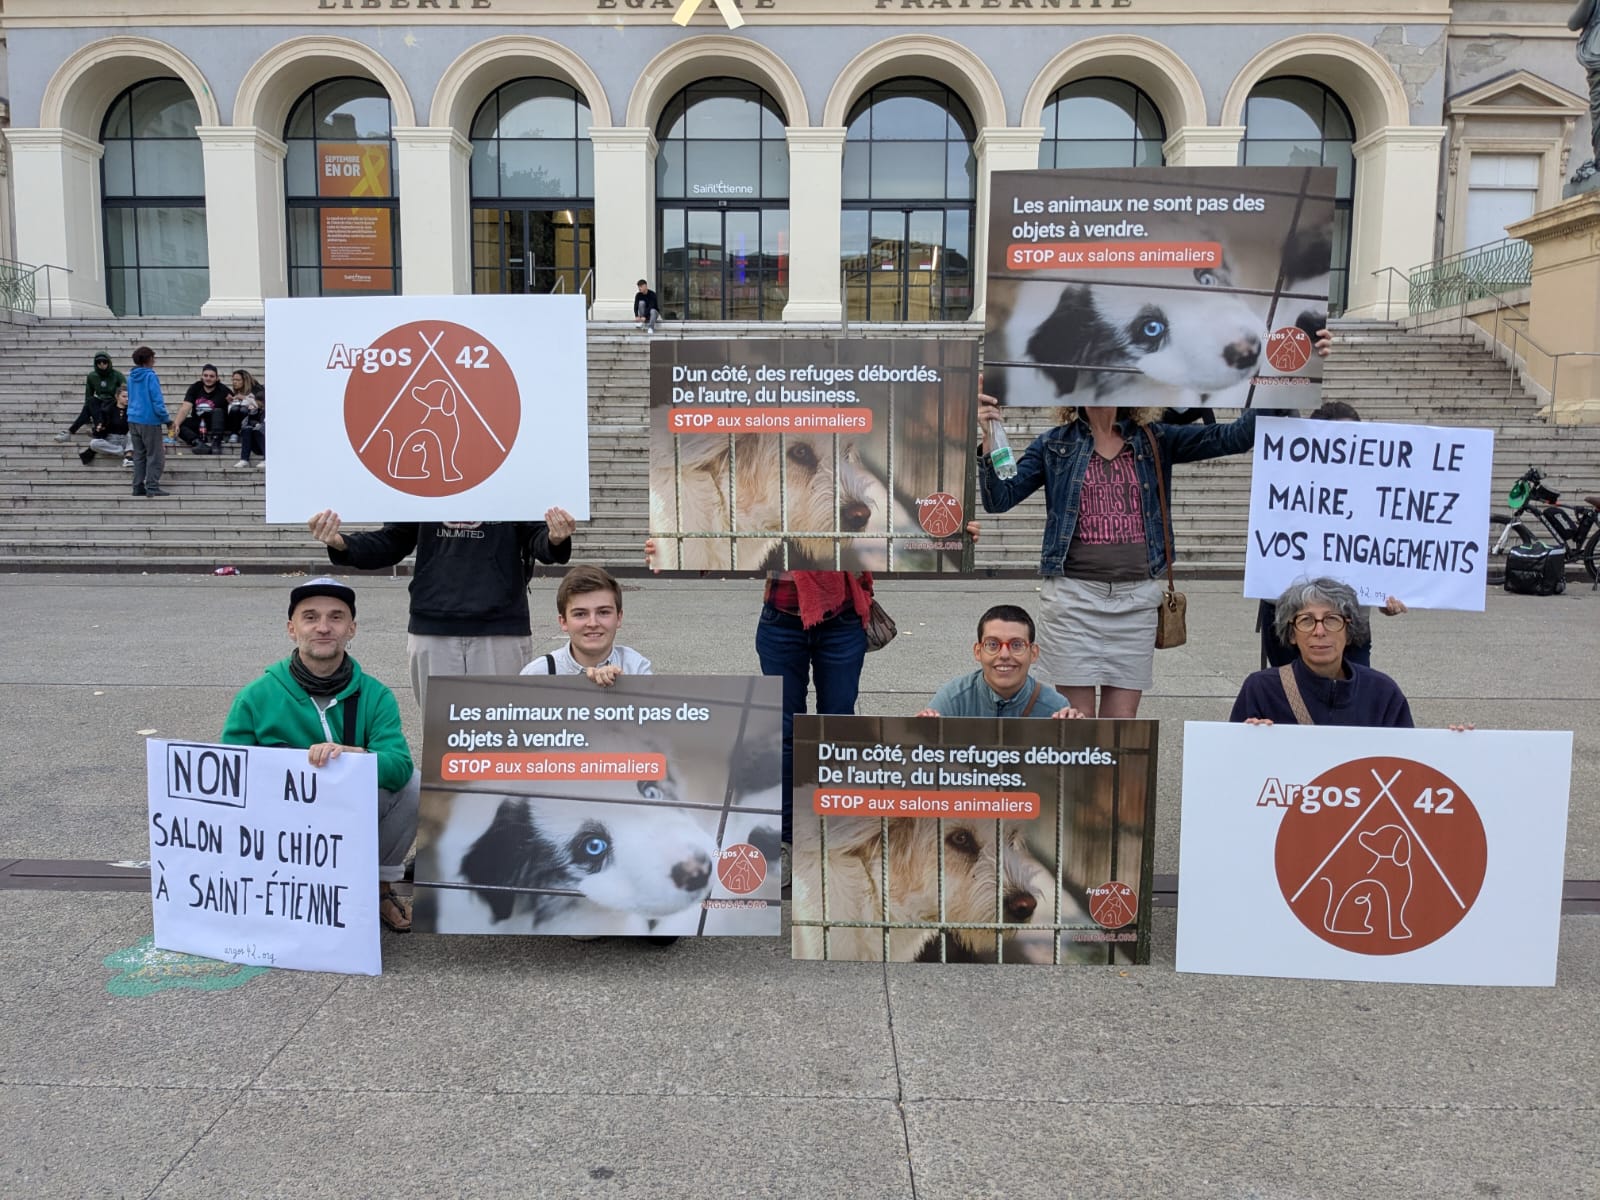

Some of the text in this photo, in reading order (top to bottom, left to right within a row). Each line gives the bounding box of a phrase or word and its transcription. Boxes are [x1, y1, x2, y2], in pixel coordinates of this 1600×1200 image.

[325, 155, 360, 163] SEPTEMBRE
[325, 164, 360, 176] EN OR
[1013, 194, 1265, 215] Les animaux ne sont pas des
[1012, 220, 1149, 242] objets à vendre.
[1013, 247, 1215, 263] STOP aux salons animaliers
[1263, 333, 1285, 341] Argos
[327, 343, 490, 374] Argos 42
[672, 365, 941, 385] D'un côté, des refuges débordés.
[672, 386, 860, 406] De l'autre, du business.
[674, 413, 866, 427] STOP aux salons animaliers
[1432, 443, 1465, 472] LE
[915, 498, 937, 506] Argos
[1079, 484, 1126, 516] GIRLS
[1376, 486, 1460, 525] TENEZ
[436, 528, 485, 539] UNLIMITED
[1255, 530, 1479, 574] VOS ENGAGEMENTS
[449, 703, 709, 725] Les animaux ne sont pas des
[447, 729, 589, 751] objets à vendre.
[818, 744, 1117, 768] D'un côté, des refuges débordés.
[448, 759, 659, 774] STOP aux salons animaliers
[174, 750, 317, 804] NON AU
[818, 767, 1026, 787] De l'autre, du business.
[820, 795, 1033, 813] STOP aux salons animaliers
[1256, 778, 1454, 814] Argos 42
[152, 813, 222, 854] SALON
[240, 825, 264, 861] DU
[712, 850, 737, 859] Argos
[156, 860, 169, 902] À
[1086, 888, 1109, 896] Argos
